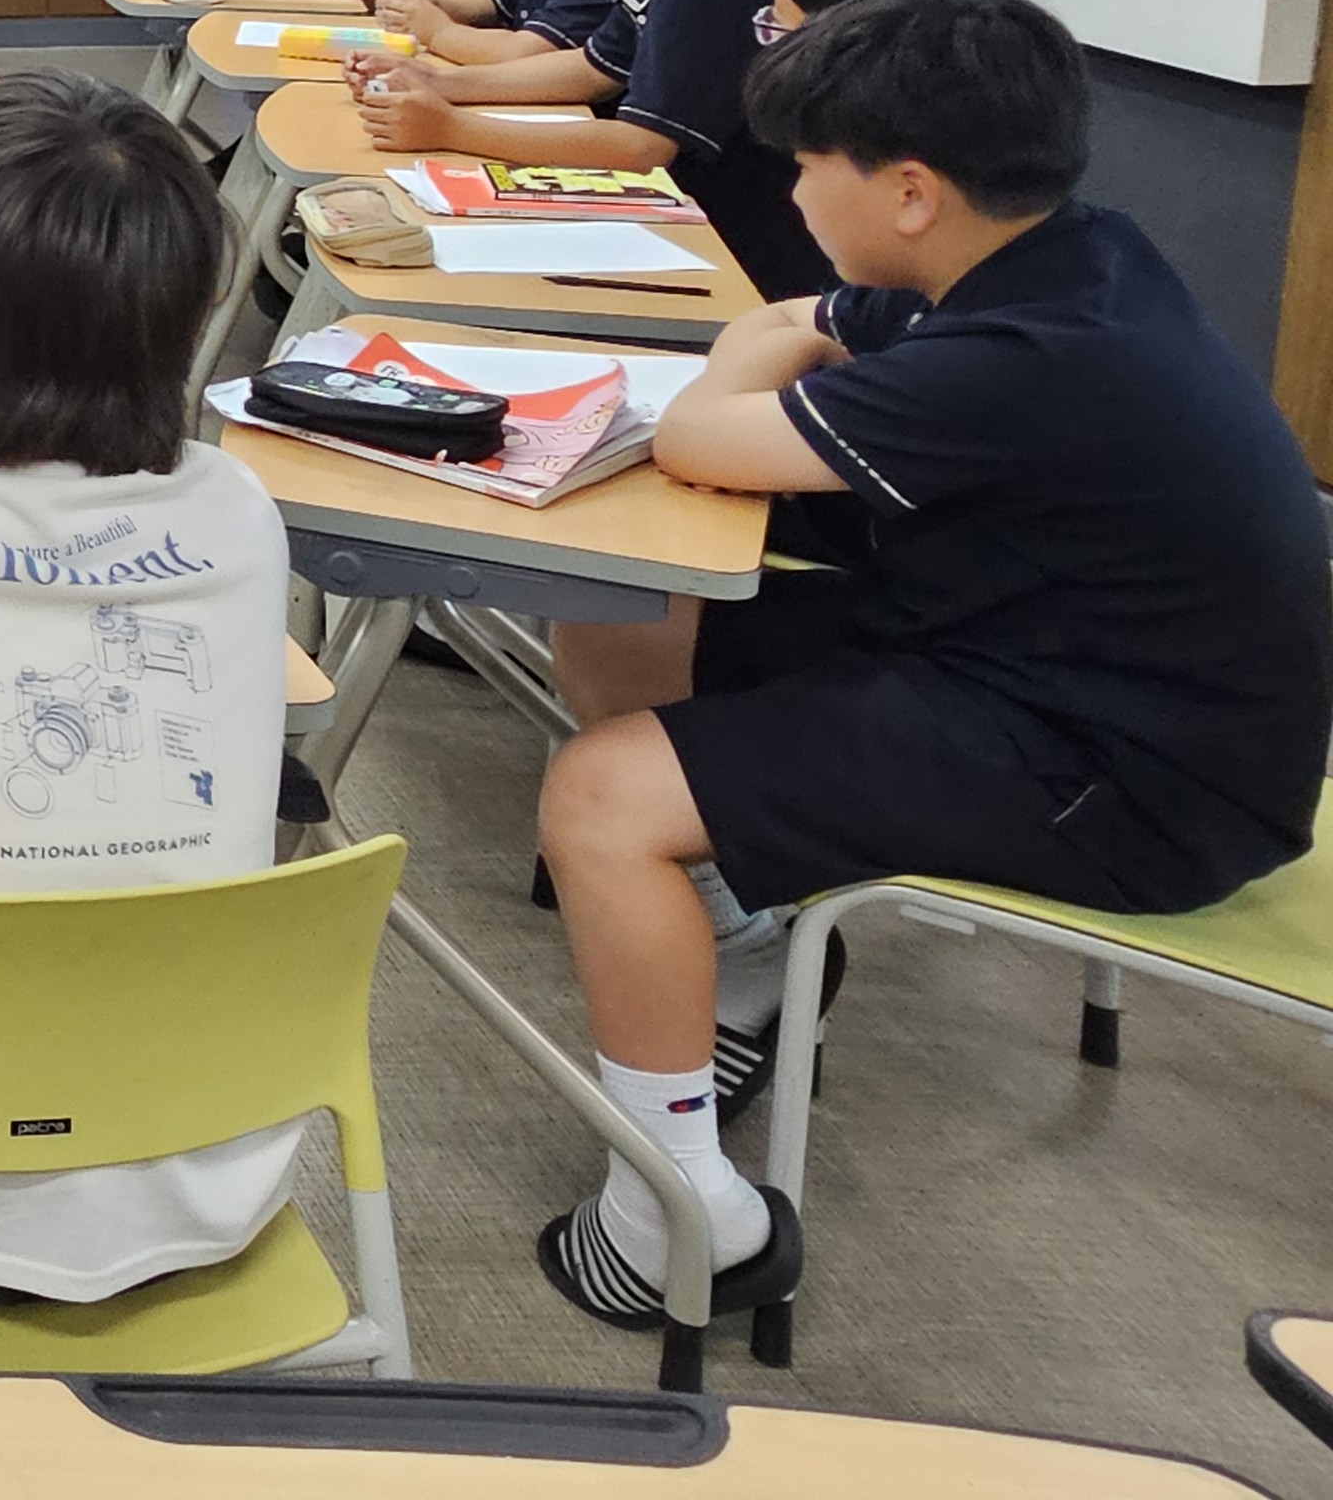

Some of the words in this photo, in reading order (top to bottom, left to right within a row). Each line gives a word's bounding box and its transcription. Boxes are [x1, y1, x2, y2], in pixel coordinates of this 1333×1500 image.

[64, 543, 74, 557] a
[74, 514, 139, 554] Beautiful
[0, 843, 99, 860] NATIONAL
[107, 832, 212, 856] GEOGRAPHIC
